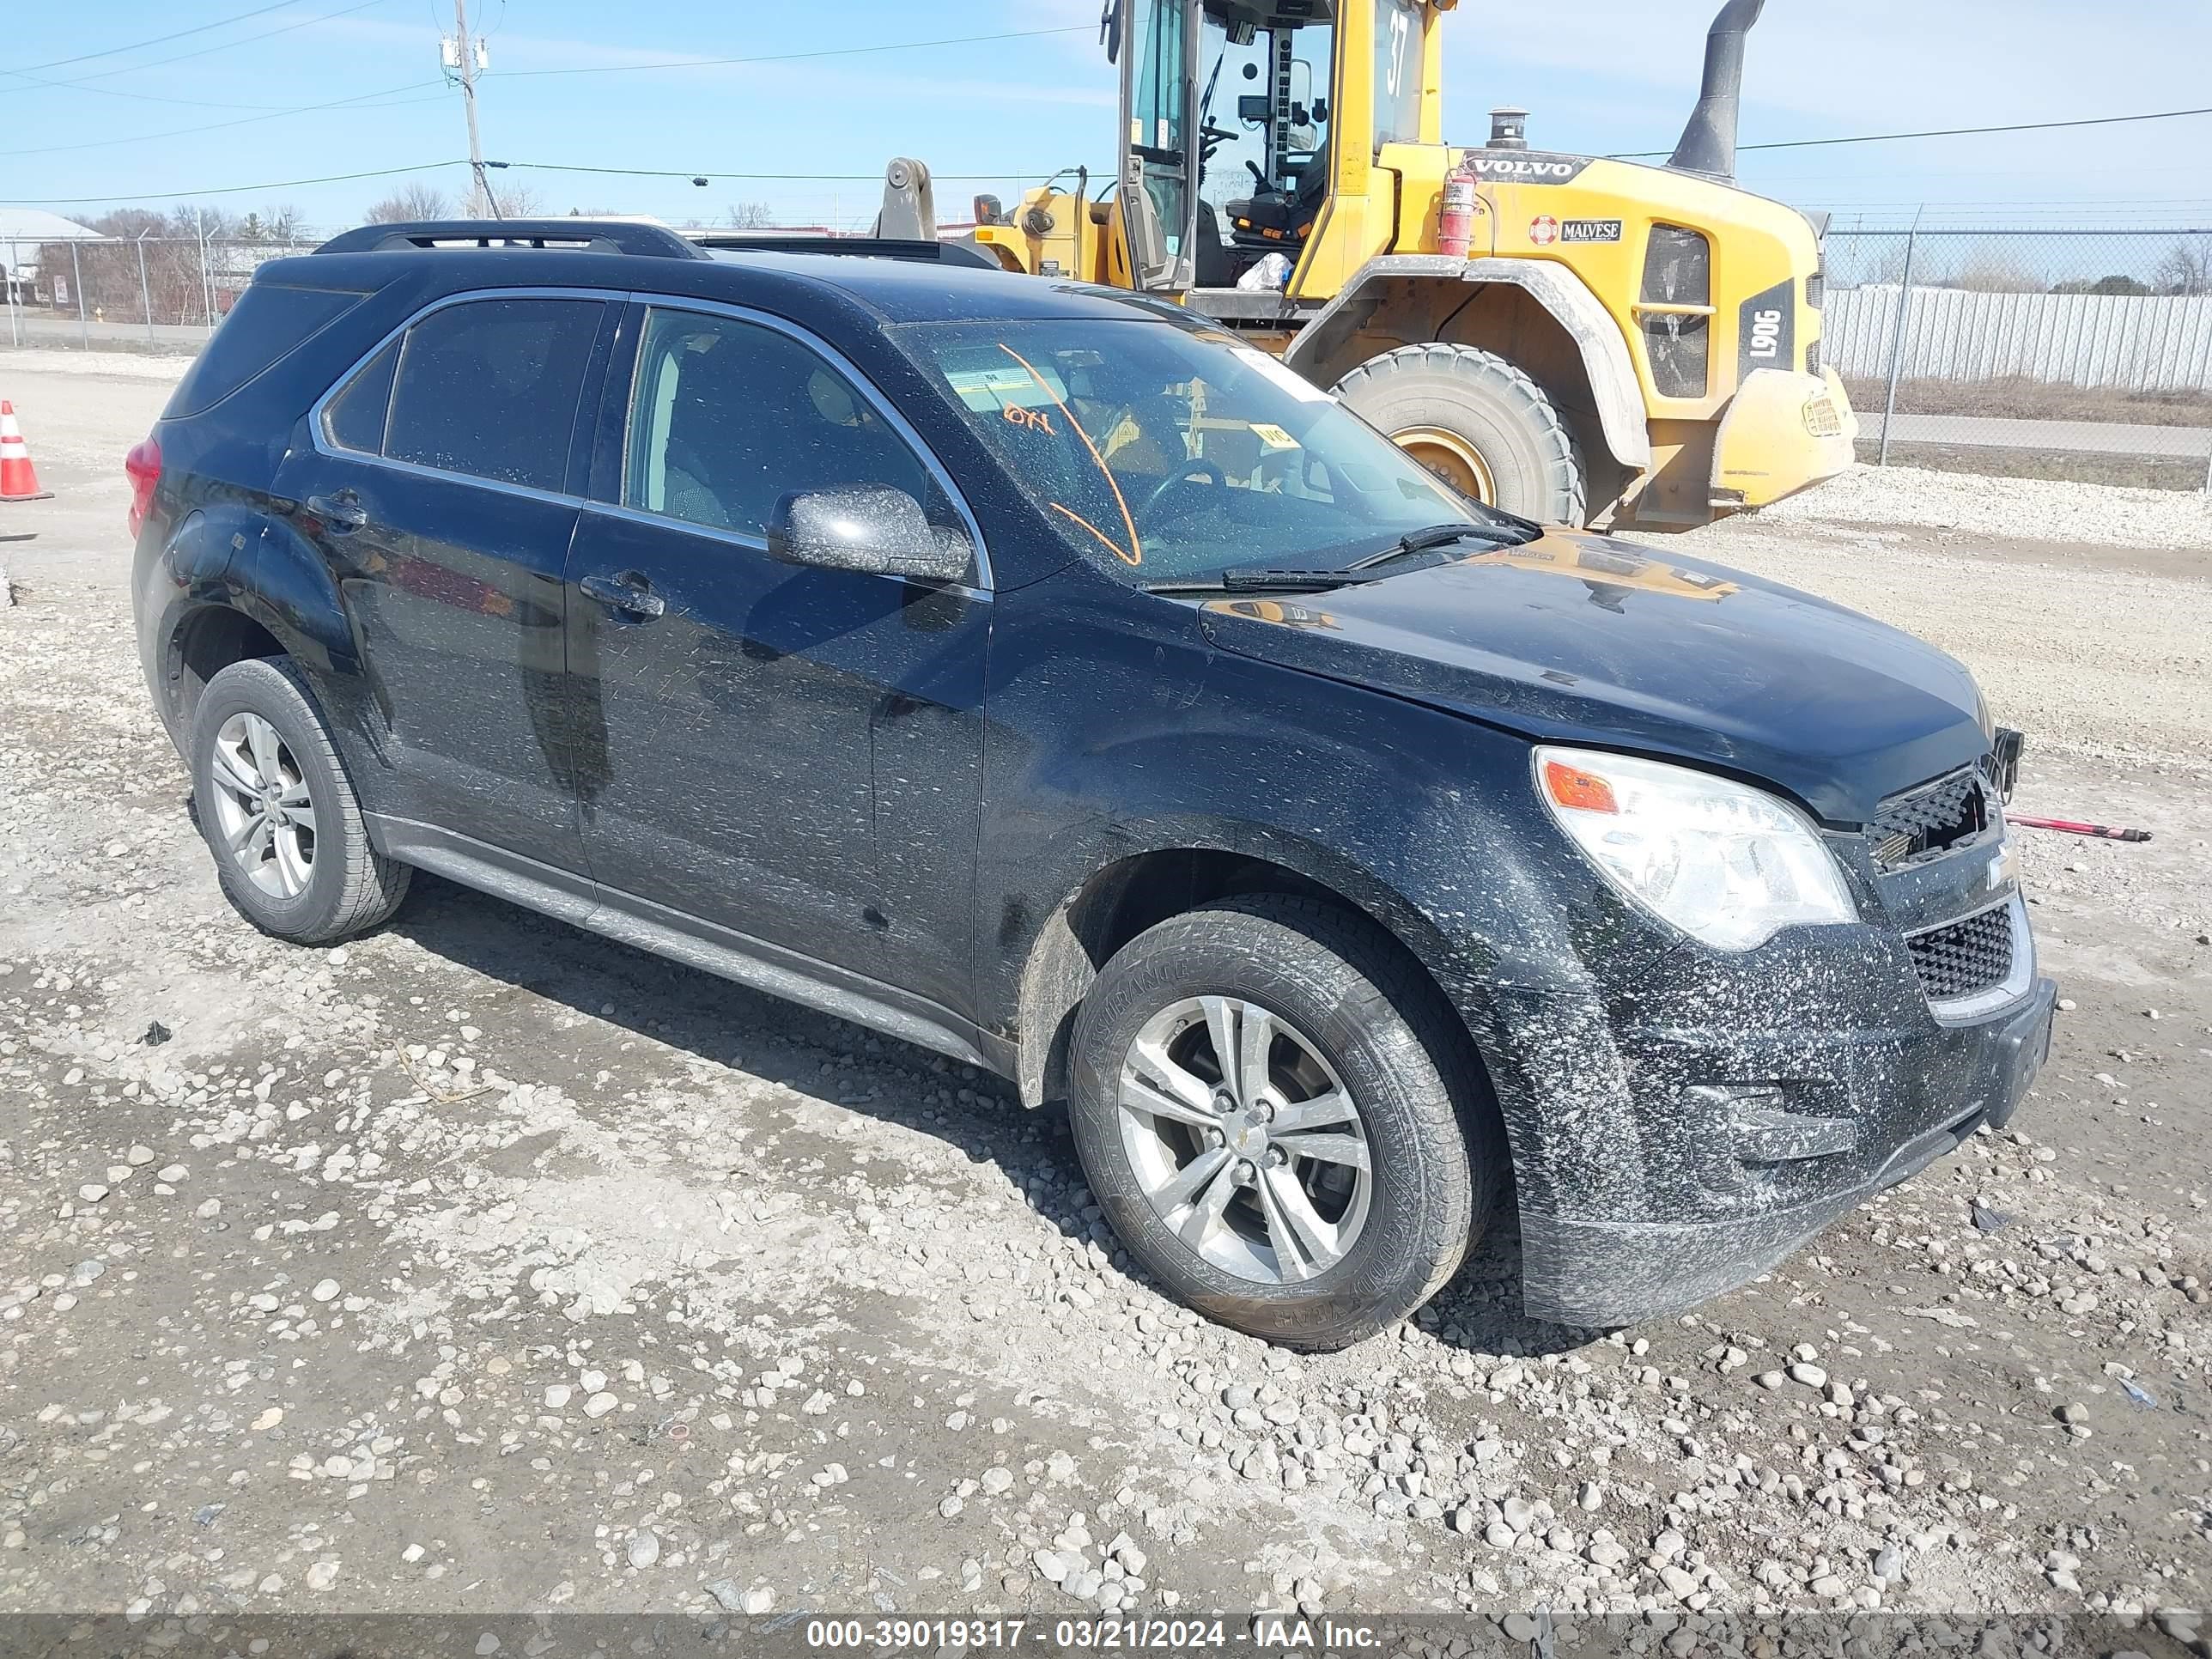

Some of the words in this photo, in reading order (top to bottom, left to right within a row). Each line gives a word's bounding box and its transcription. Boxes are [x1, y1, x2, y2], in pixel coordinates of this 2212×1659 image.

[1387, 9, 1408, 98] 37
[1472, 159, 1573, 177] VOLVO
[1564, 223, 1620, 239] MALVESE
[1749, 309, 1782, 358] L90G
